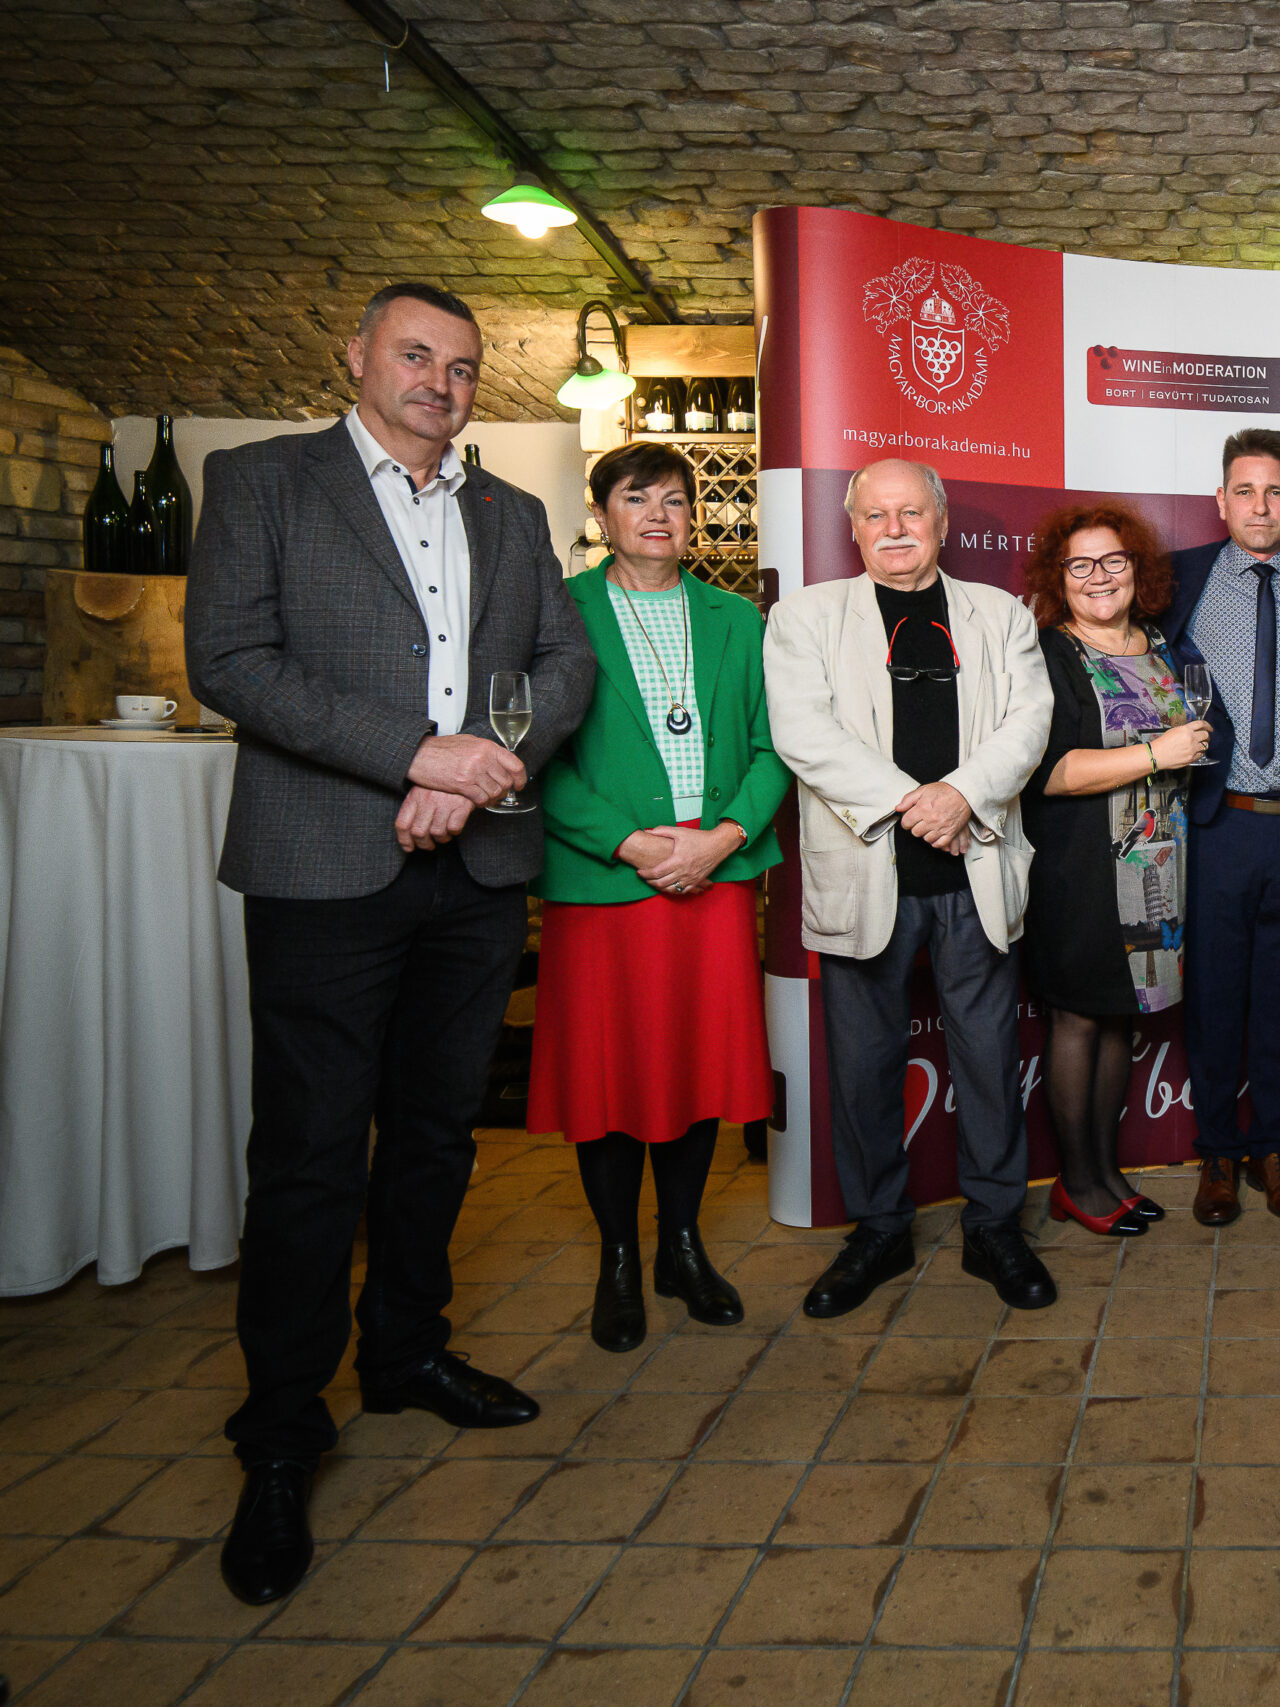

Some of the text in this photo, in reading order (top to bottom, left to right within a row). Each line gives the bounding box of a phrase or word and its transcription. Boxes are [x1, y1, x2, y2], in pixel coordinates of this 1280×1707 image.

[1105, 388, 1270, 405] BORT EGYÜTT TUDATOSAN
[843, 427, 1031, 458] magyarborakademia.hu
